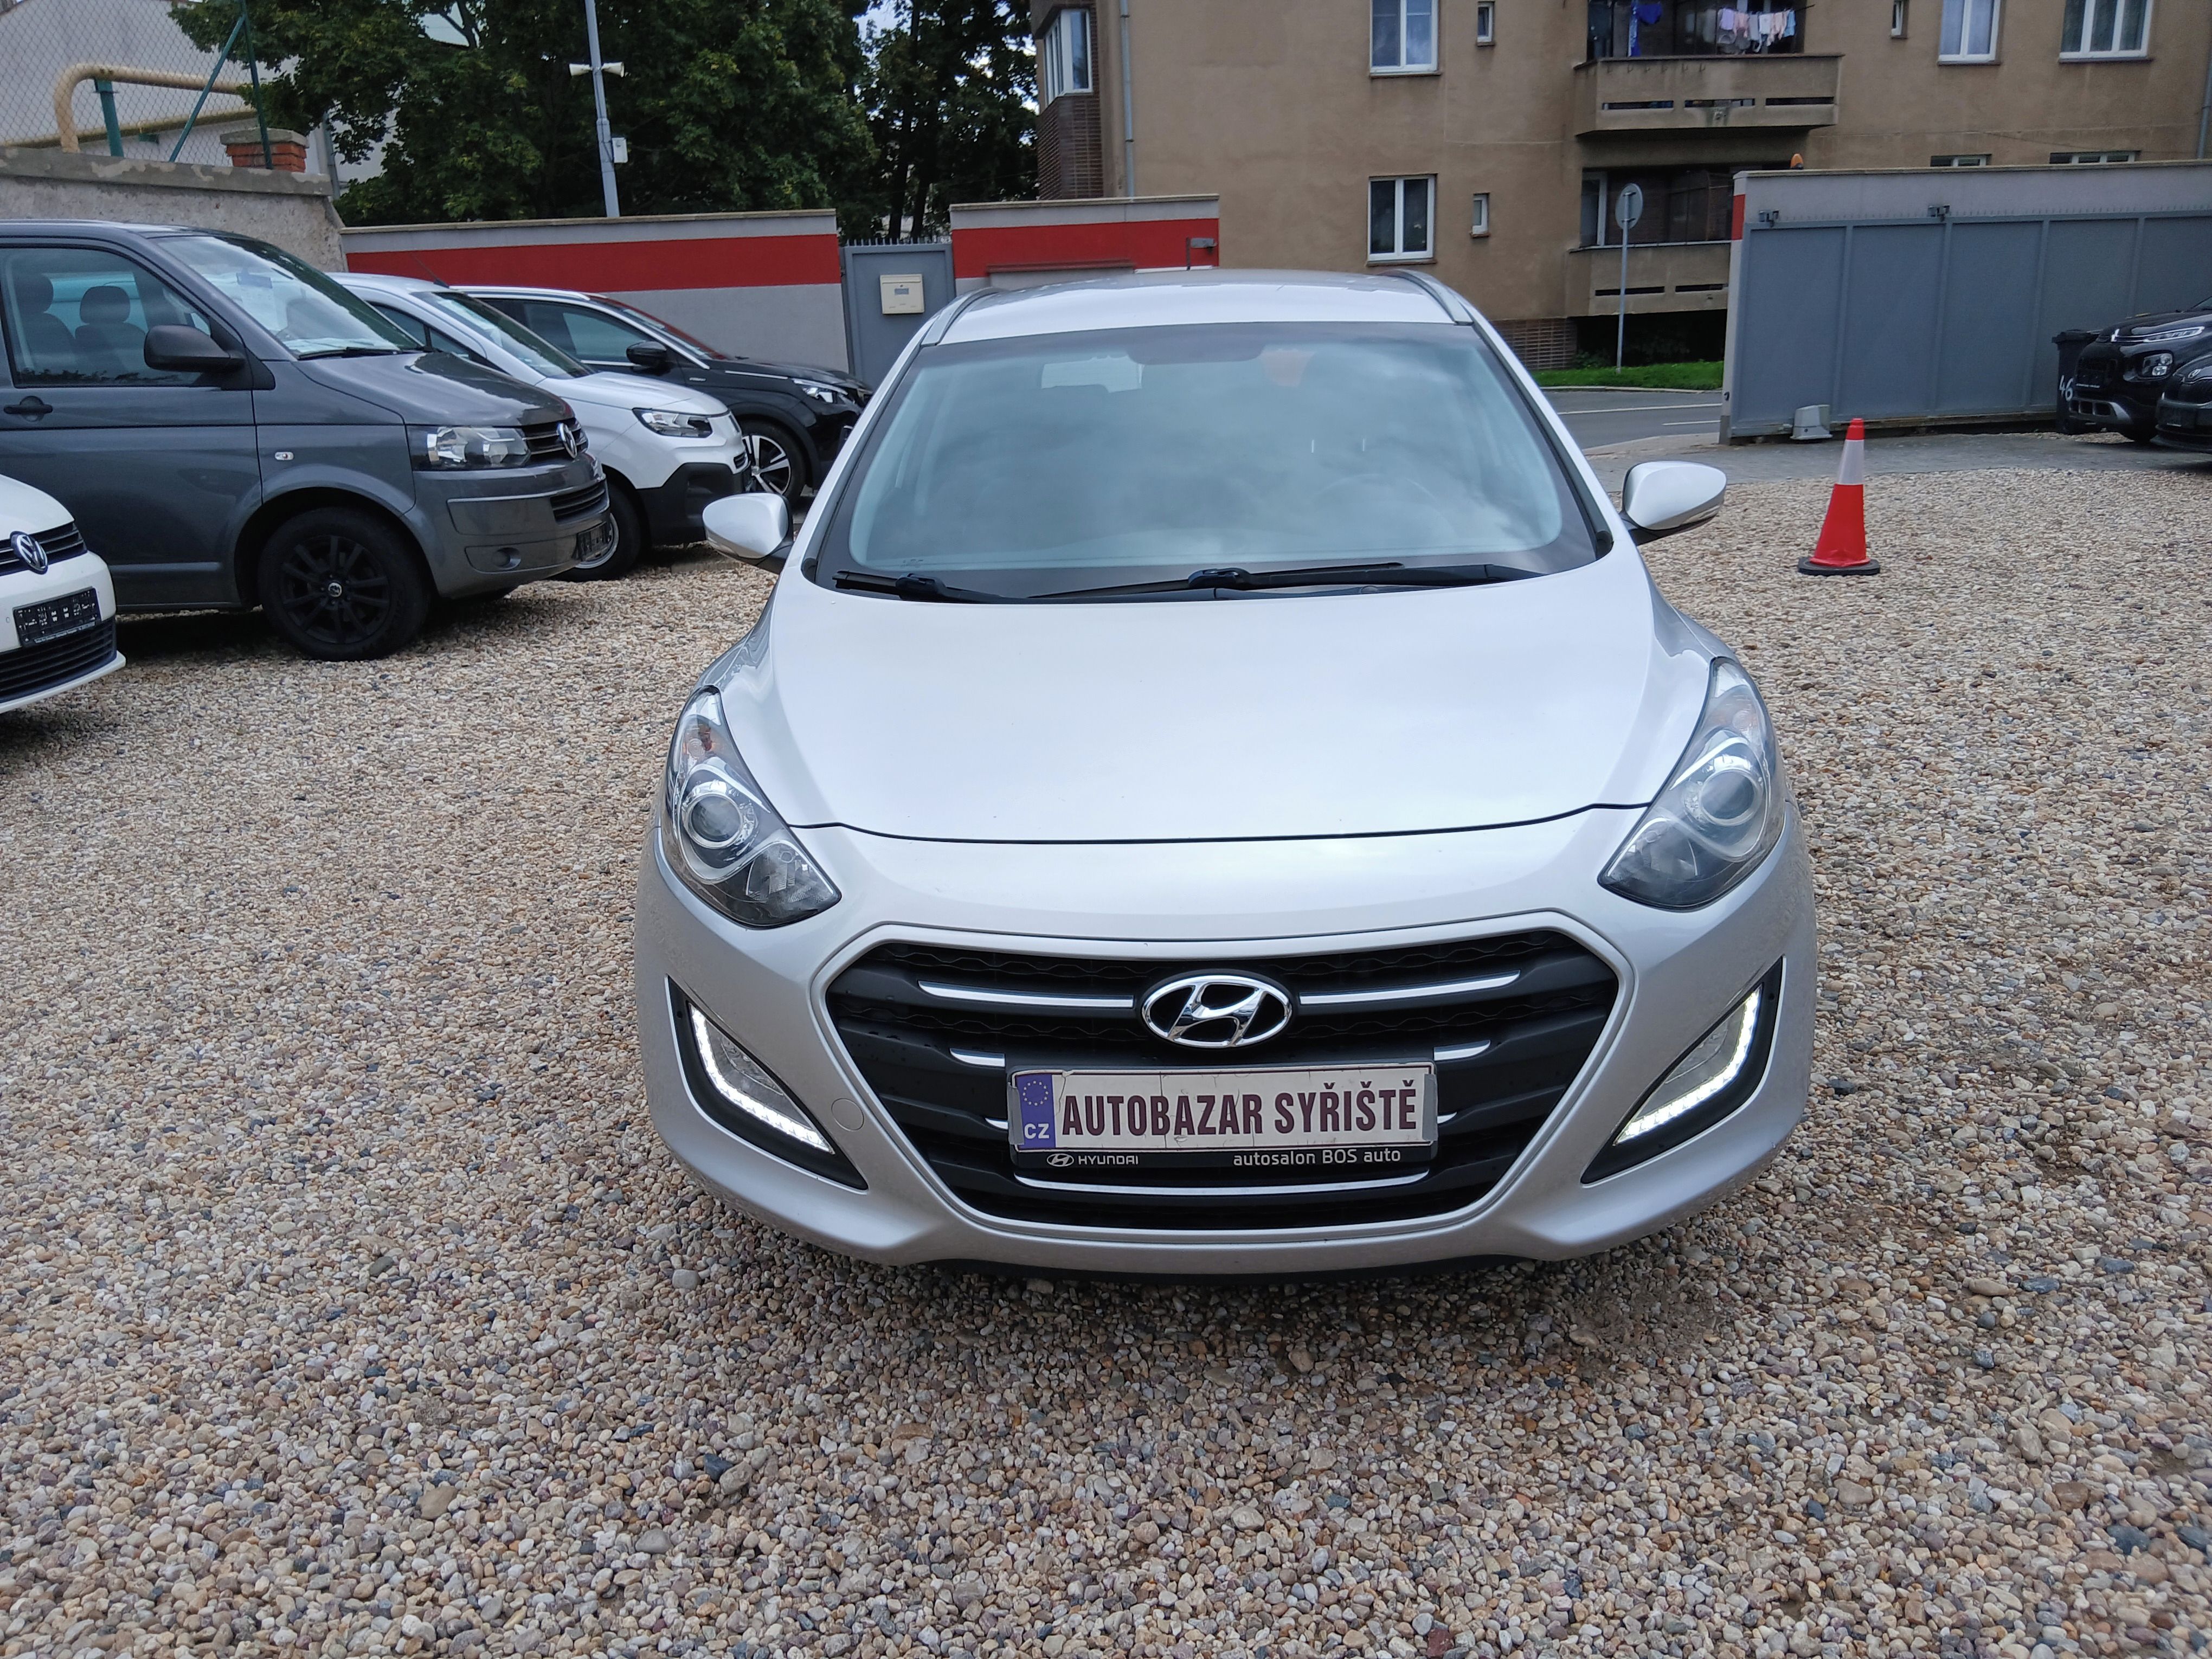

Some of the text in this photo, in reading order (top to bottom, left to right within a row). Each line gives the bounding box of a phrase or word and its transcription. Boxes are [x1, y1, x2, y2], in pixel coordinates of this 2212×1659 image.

[2059, 375, 2074, 401] 46
[1062, 1079, 1416, 1136] AUTOBAZAR SYŘIŠTĚ
[1024, 1123, 1050, 1139] CZ
[1078, 1155, 1139, 1165] HYUNDAI
[1233, 1148, 1401, 1166] autosalon BOS auto
